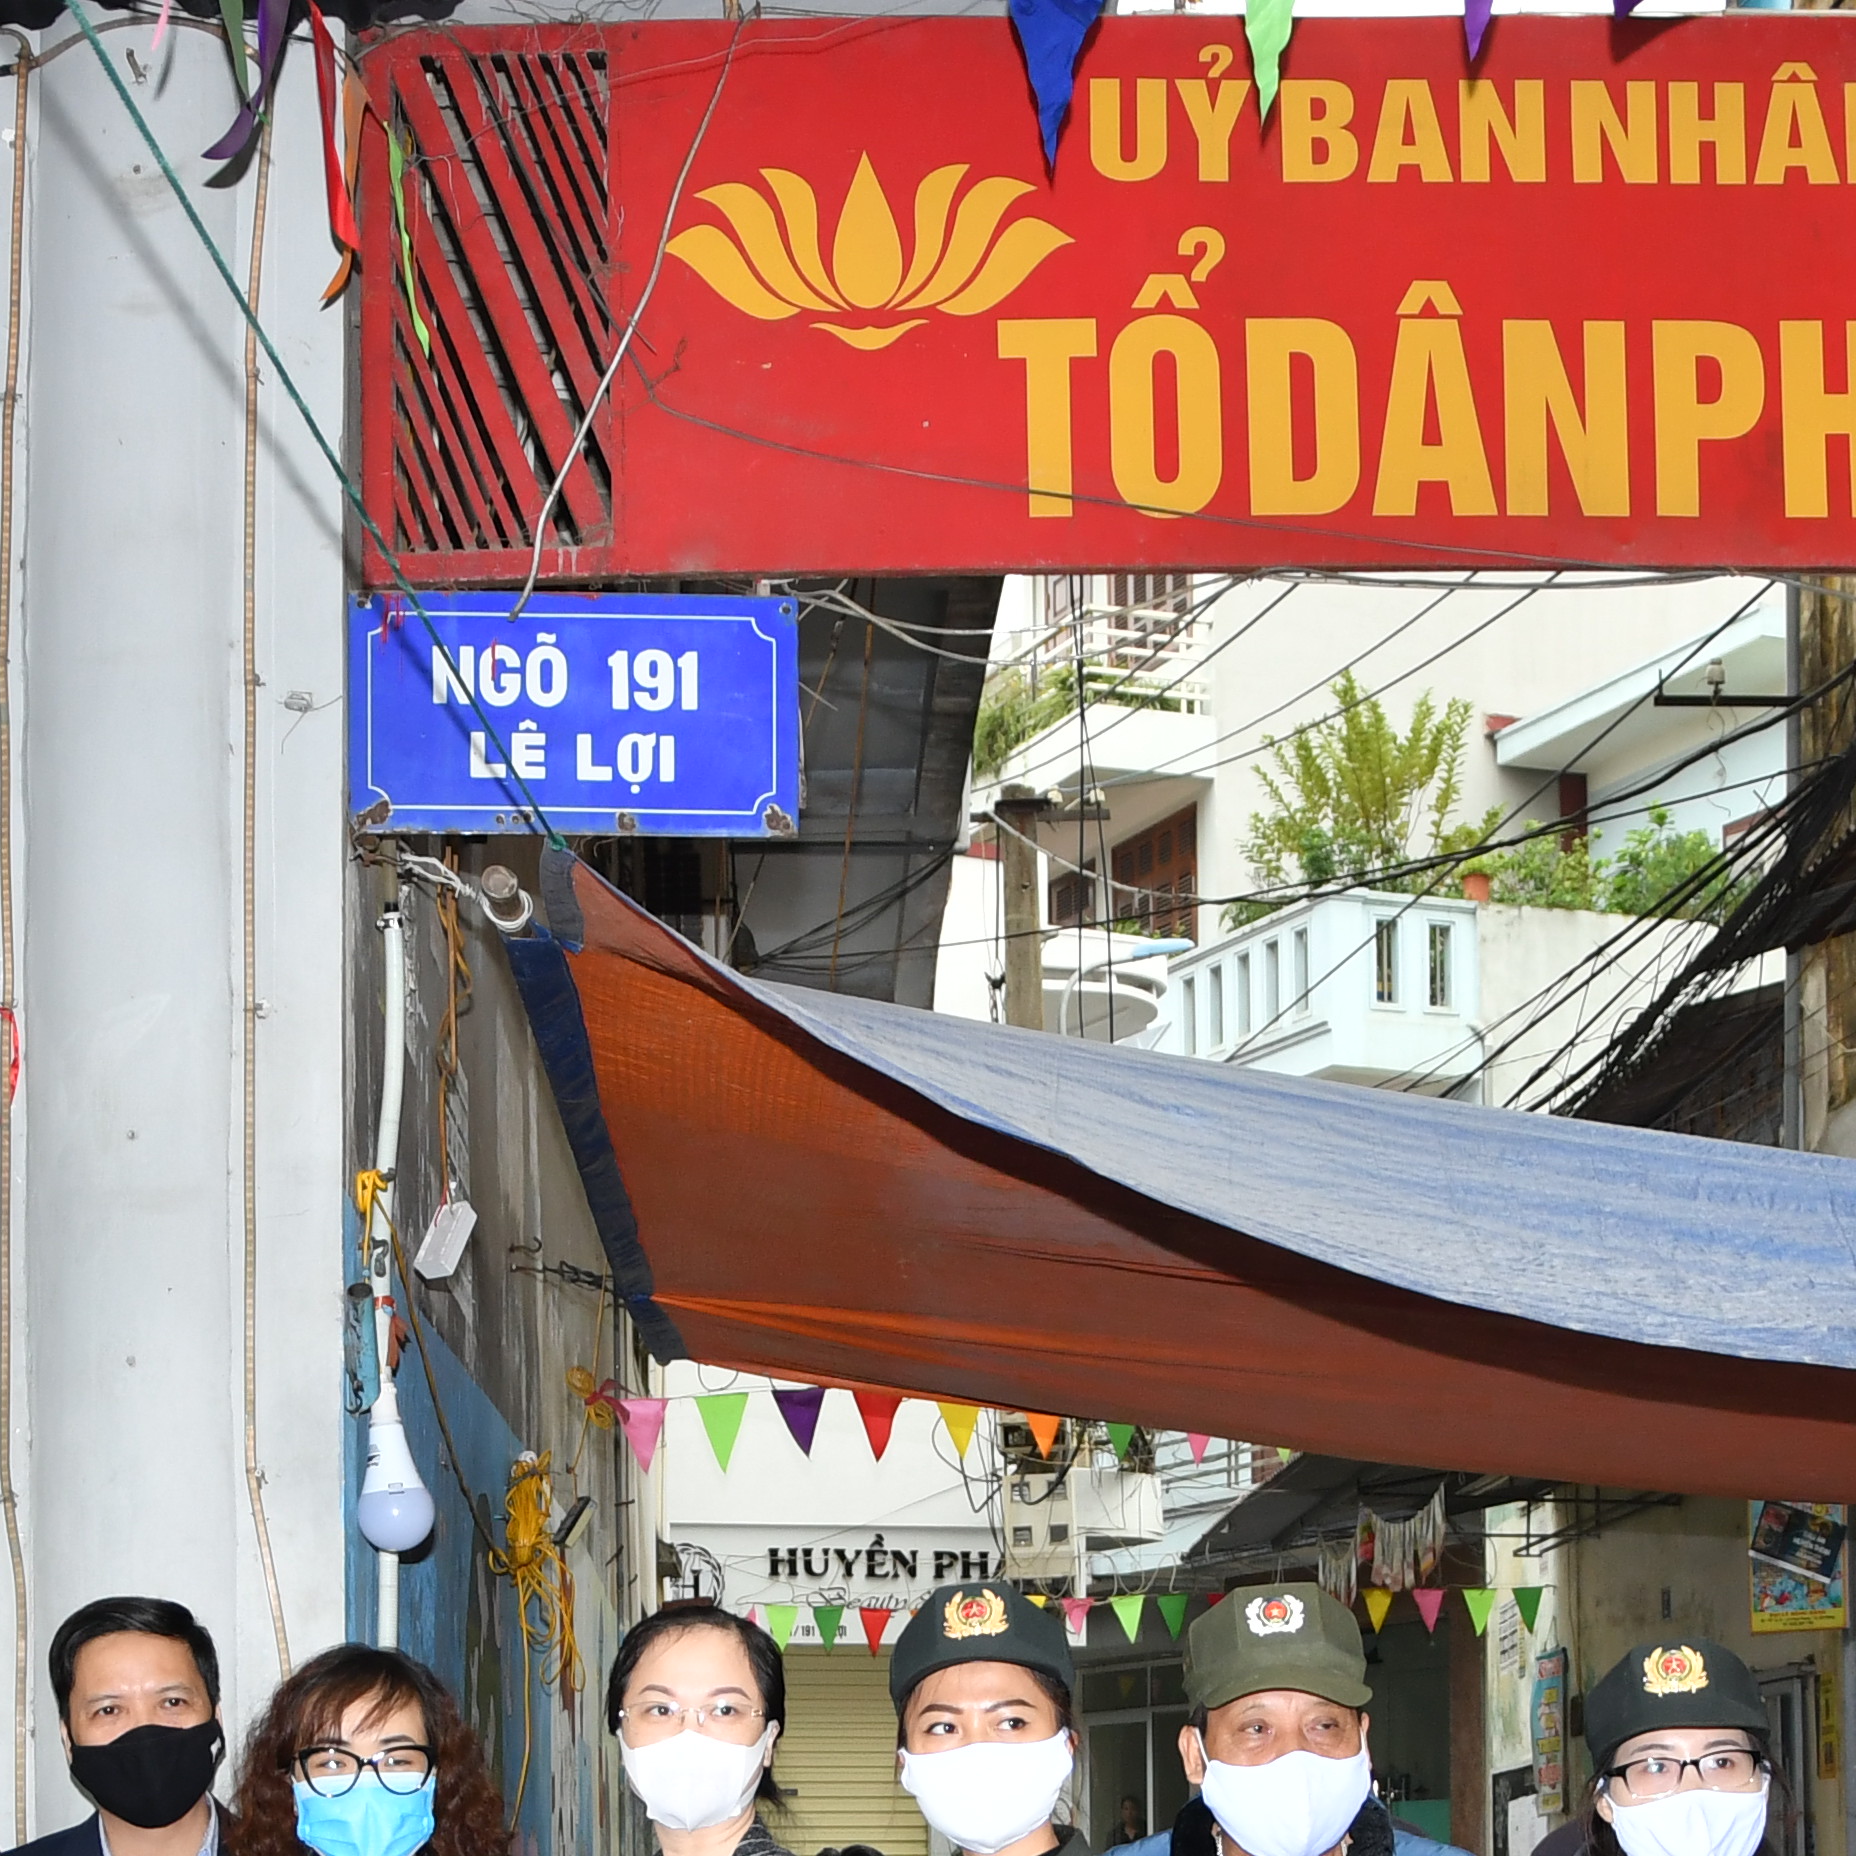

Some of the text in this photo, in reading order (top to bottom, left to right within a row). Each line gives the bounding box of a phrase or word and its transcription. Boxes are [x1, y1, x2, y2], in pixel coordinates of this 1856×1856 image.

[1092, 46, 1249, 181] UỶ
[1277, 80, 1545, 181] BAN
[999, 228, 1224, 518] TỔ
[1247, 282, 1629, 517] DÂN
[432, 633, 699, 712] NGÕ 191
[470, 719, 676, 795] LÊ LỢI
[768, 1533, 918, 1580] HUYỀN
